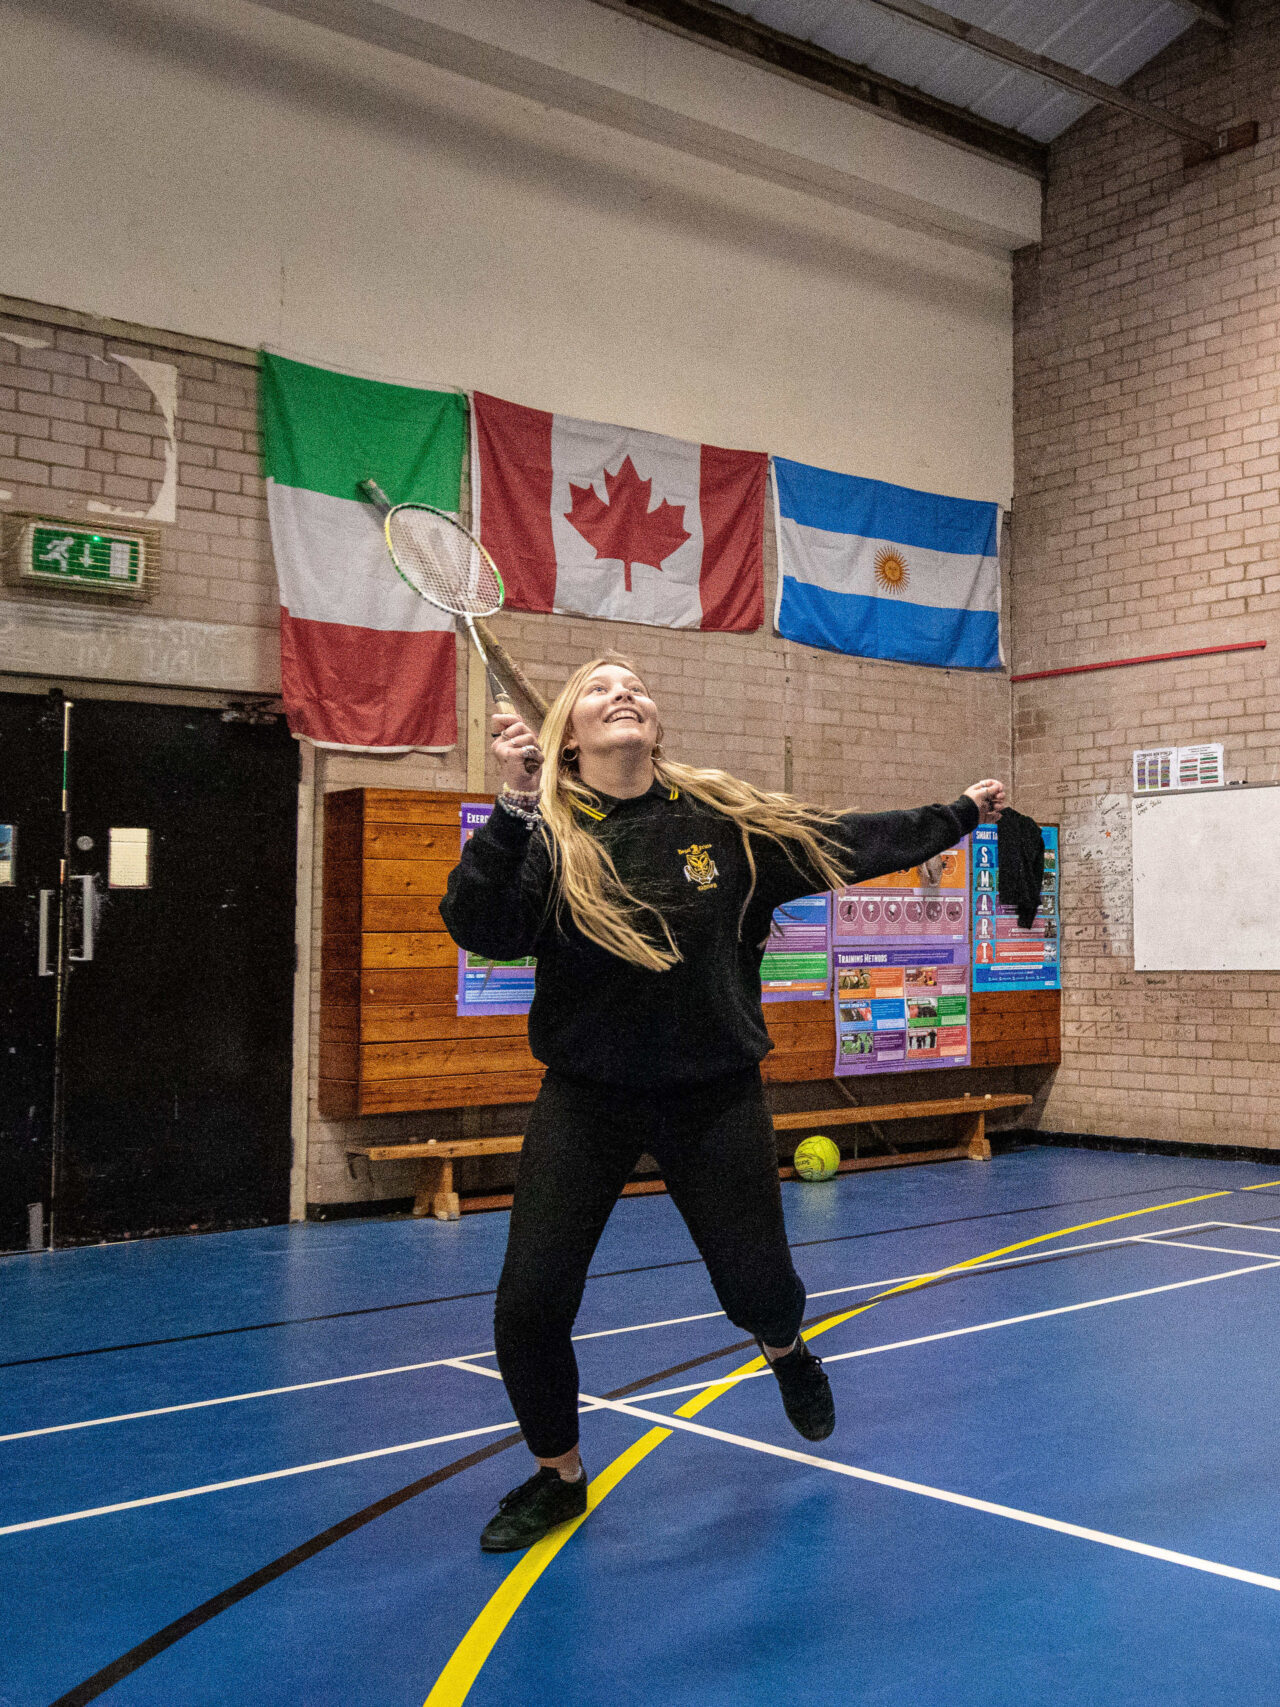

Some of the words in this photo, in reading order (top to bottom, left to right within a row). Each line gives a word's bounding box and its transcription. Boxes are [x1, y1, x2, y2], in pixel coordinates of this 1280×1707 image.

[976, 830, 992, 840] SMART
[838, 954, 864, 964] TRAINING
[864, 953, 887, 963] METHODS
